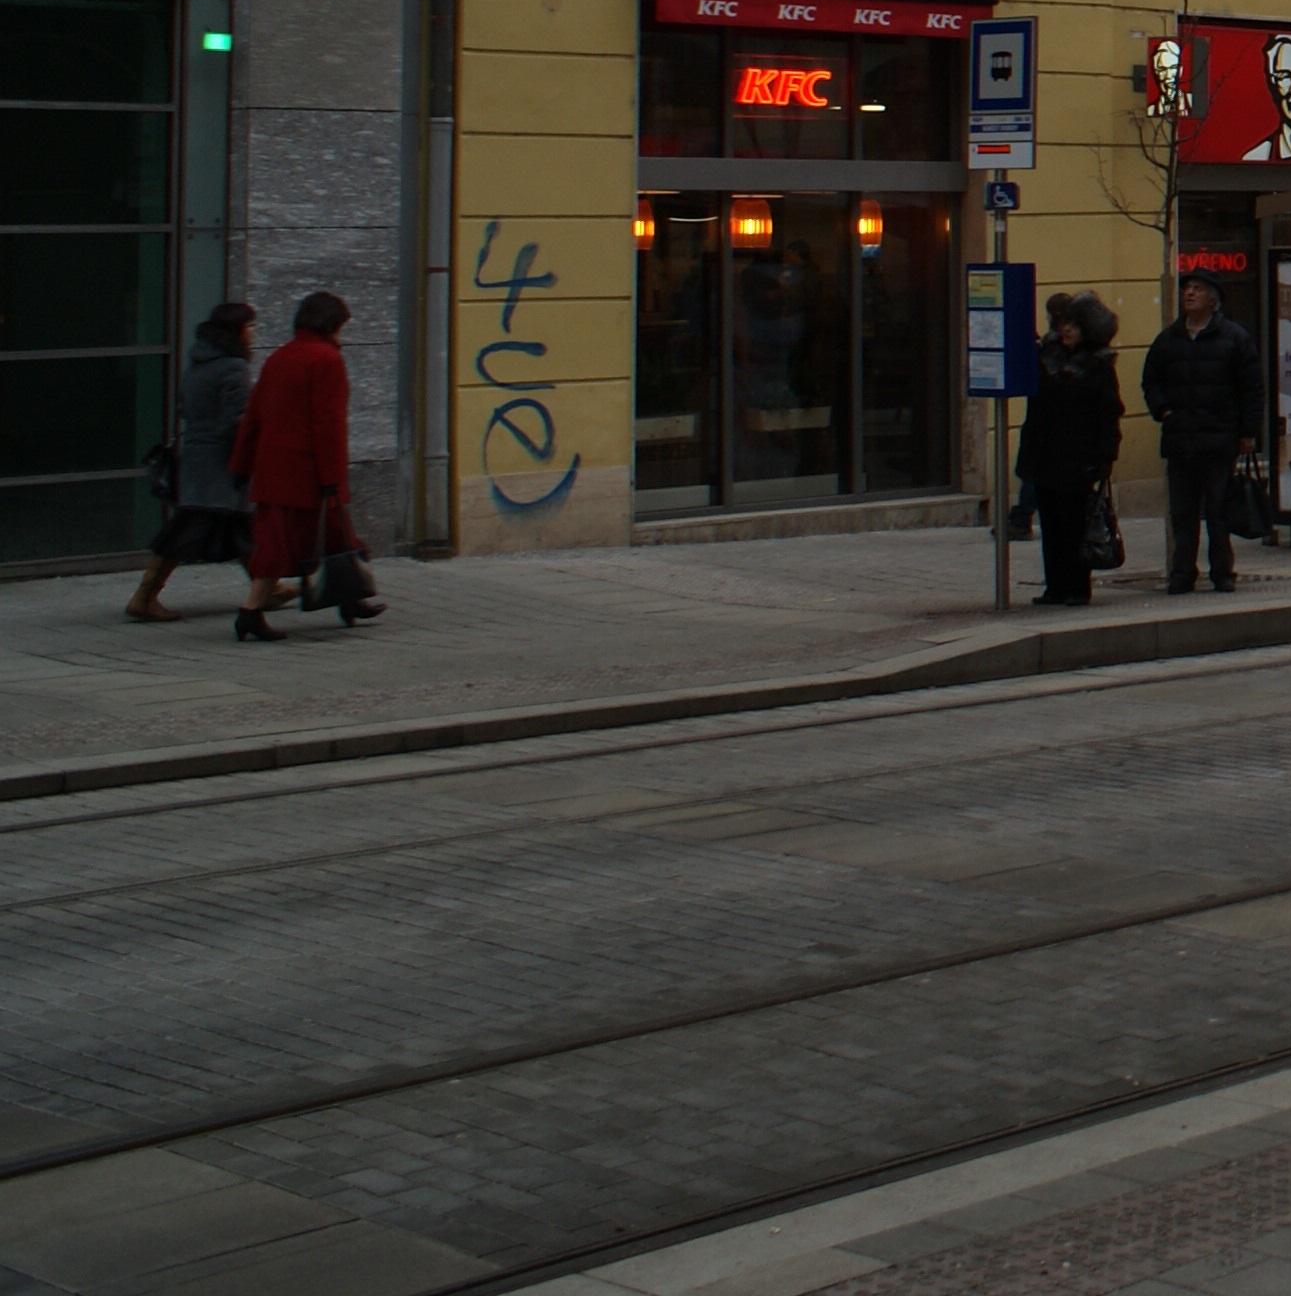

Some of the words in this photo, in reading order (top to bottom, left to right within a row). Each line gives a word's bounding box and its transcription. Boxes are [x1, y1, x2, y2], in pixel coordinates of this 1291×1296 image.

[697, 0, 738, 17] KFC
[778, 4, 817, 21] KFC
[854, 9, 892, 26] KFC
[926, 13, 962, 30] KFC
[739, 67, 832, 106] KFC
